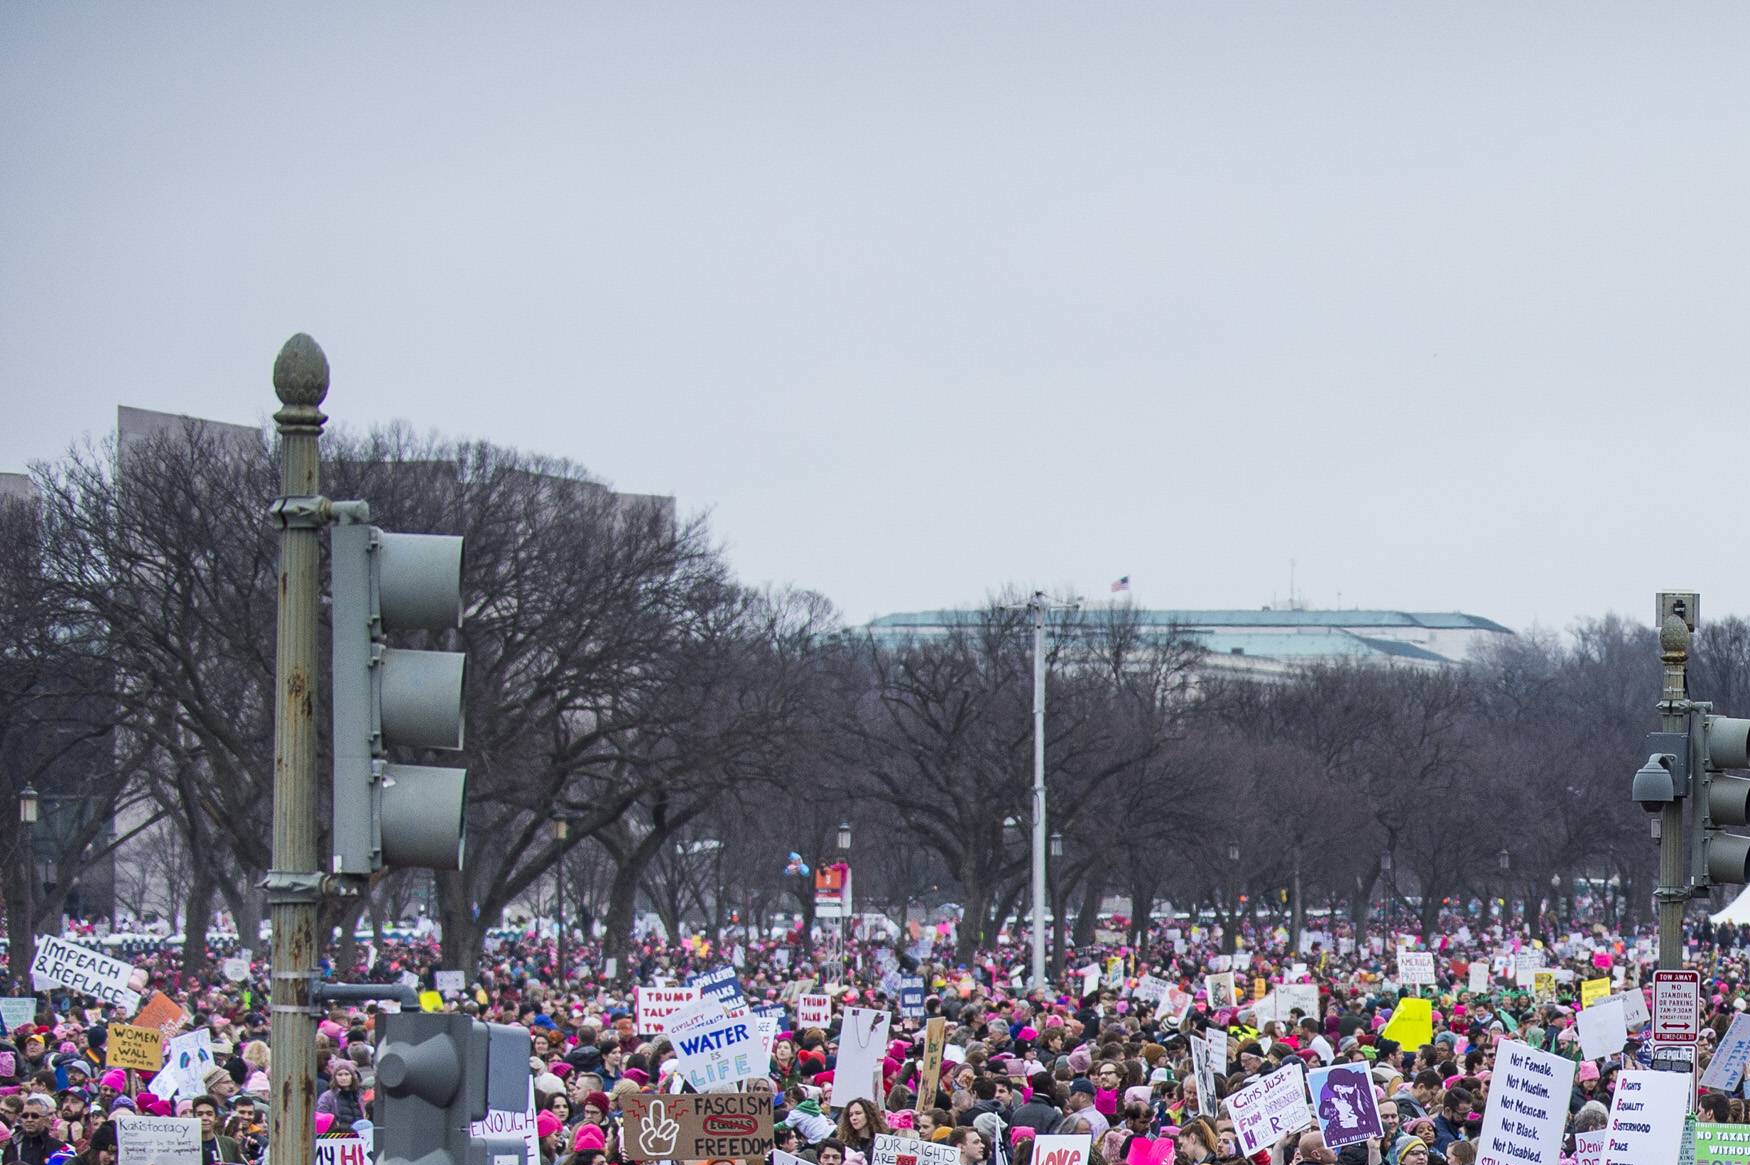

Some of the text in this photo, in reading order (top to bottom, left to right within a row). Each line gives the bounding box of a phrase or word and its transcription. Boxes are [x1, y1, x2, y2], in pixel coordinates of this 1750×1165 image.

[43, 937, 121, 979] IMPEACH
[35, 955, 125, 1004] & REPLACE
[1674, 973, 1693, 981] AWAY
[646, 991, 693, 1003] TRUMP
[803, 997, 828, 1007] TRUMP
[801, 1012, 823, 1022] TALKS
[113, 1027, 161, 1045] WOMEN
[679, 1023, 750, 1057] WATER
[118, 1046, 148, 1060] WALL
[690, 1053, 752, 1089] LIFE
[1510, 1052, 1554, 1078] Not Female.
[1506, 1073, 1551, 1099] Not Muslim.
[1620, 1078, 1642, 1092] RIGHTS
[694, 1096, 773, 1116] FASCISM
[1500, 1094, 1549, 1121] Not Mexican.
[1616, 1099, 1644, 1112] EQUALITY
[119, 1117, 191, 1135] Kakistocracy
[471, 1109, 536, 1137] ENOUGH
[1501, 1117, 1540, 1141] Not Black.
[1612, 1118, 1651, 1133] SISTERHOOD
[1609, 1138, 1628, 1152] PEACE
[1697, 1131, 1712, 1141] NO
[694, 1137, 774, 1157] FREEDOM
[874, 1135, 957, 1163] OUR RIGHTS
[1492, 1137, 1543, 1165] Not Disabled.
[873, 1152, 896, 1165] ARE
